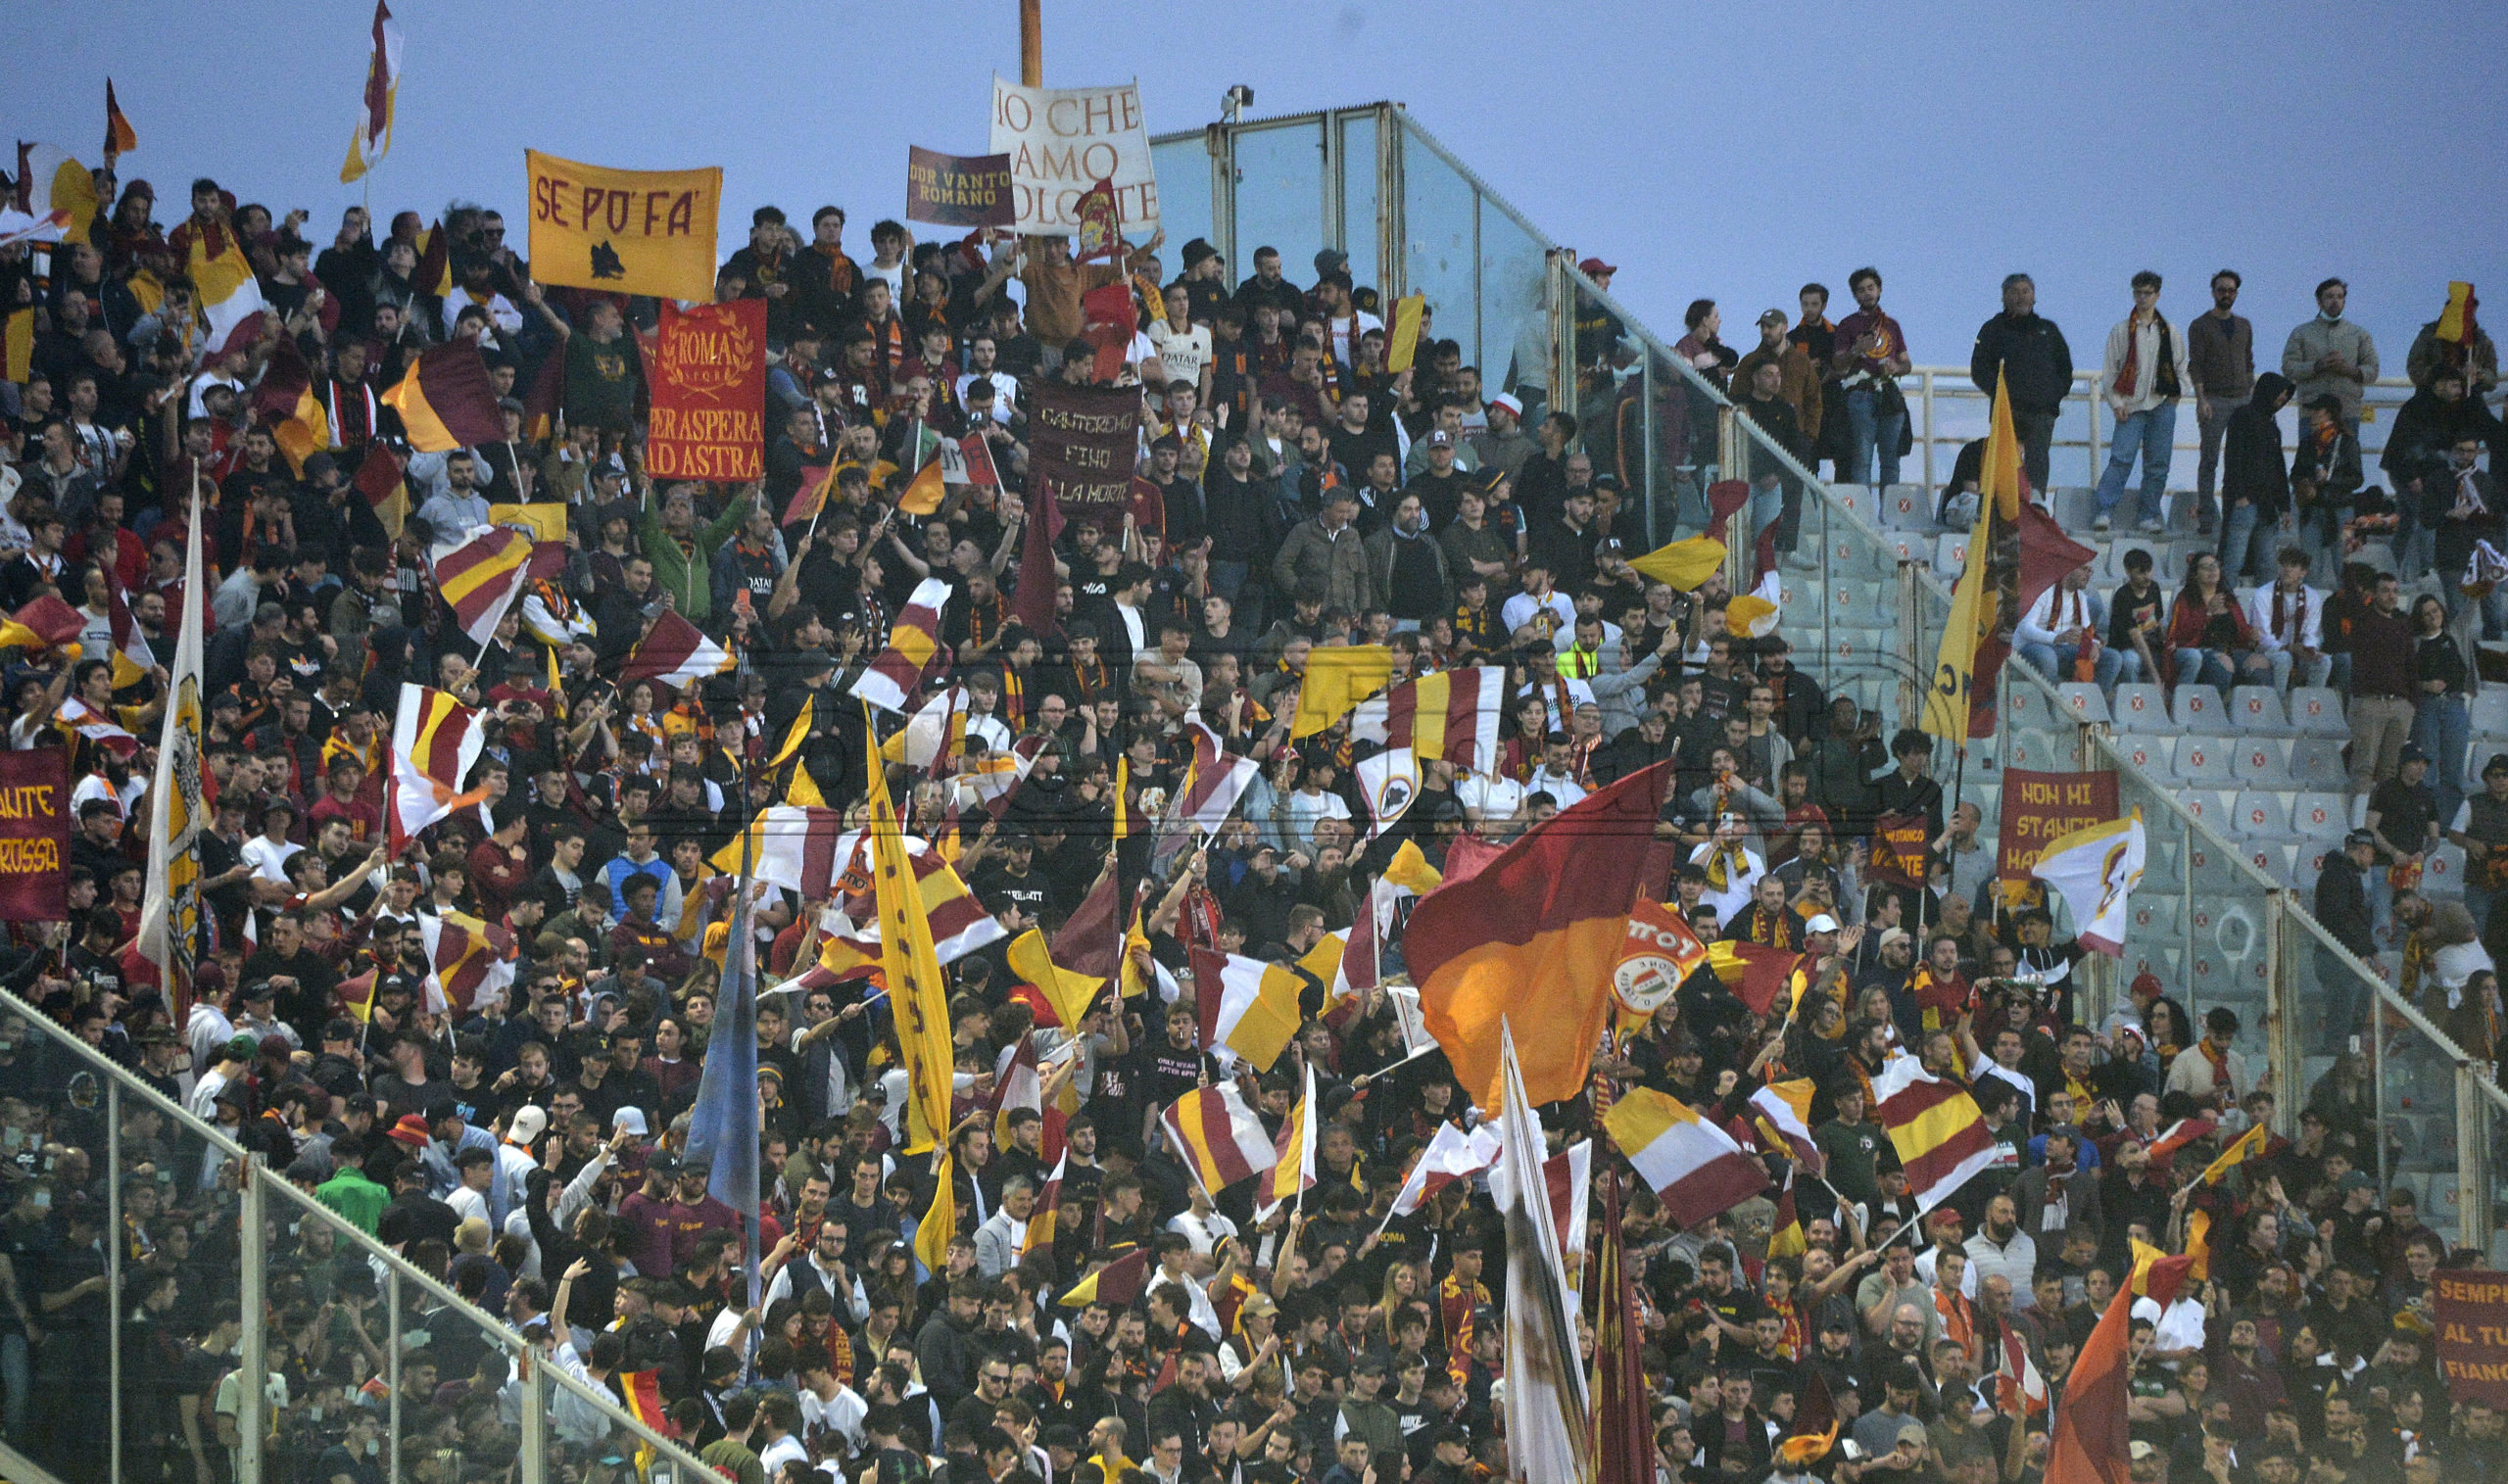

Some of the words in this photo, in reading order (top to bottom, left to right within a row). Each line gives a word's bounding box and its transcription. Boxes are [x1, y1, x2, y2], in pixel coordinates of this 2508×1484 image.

[997, 87, 1032, 131] IO
[1047, 90, 1138, 137] CHE
[1014, 140, 1118, 181] AMO
[920, 185, 996, 206] ROMANO
[943, 171, 1010, 189] VANTO
[536, 176, 569, 226] SE
[1114, 181, 1159, 223] TE
[679, 331, 734, 366] ROMA
[680, 409, 763, 442] ASPERA
[681, 445, 763, 478] ASTRA
[1066, 446, 1110, 469] FINO
[1086, 480, 1130, 503] MORTE
[2021, 782, 2059, 805] NON
[2067, 783, 2092, 805] MI
[2444, 1322, 2473, 1344] AL
